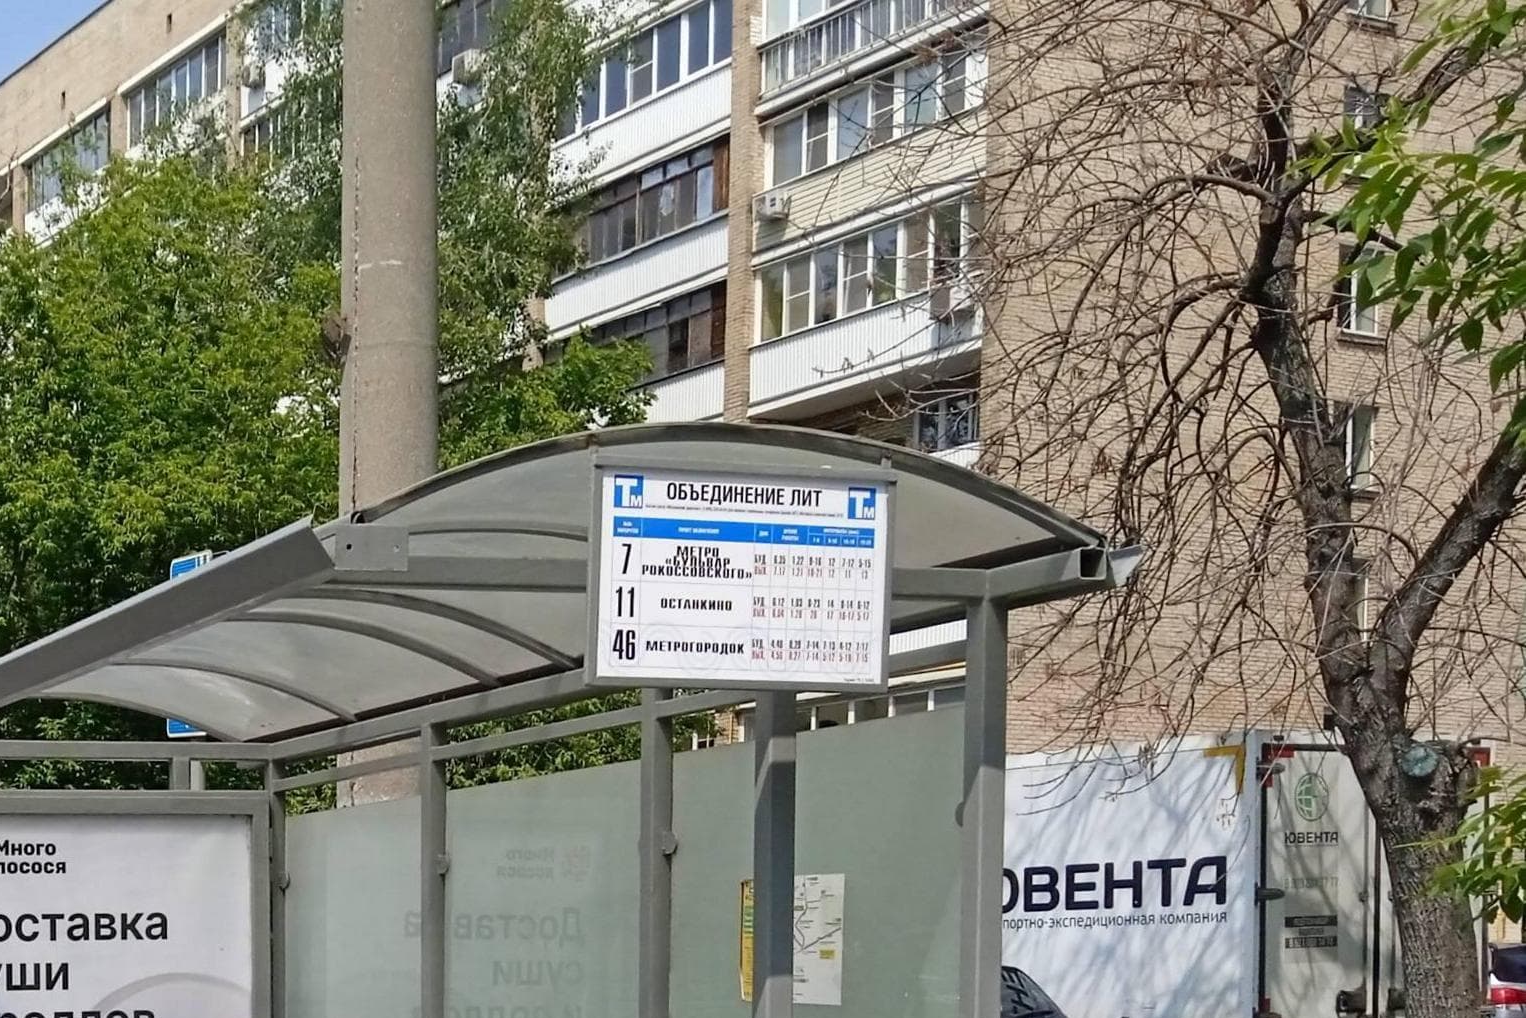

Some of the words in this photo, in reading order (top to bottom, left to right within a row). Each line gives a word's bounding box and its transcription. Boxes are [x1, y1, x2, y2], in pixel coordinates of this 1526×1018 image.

[667, 482, 785, 506] ОБЪЕДИНЕНИЕ
[790, 489, 823, 507] ЛИТ
[621, 543, 632, 575] 7
[676, 545, 720, 558] МЕТРО
[641, 564, 753, 580] РОКОССОВСКОГО»
[615, 586, 635, 618] 11
[660, 598, 733, 612] ОСТАНКИНО
[612, 629, 636, 660] 46
[645, 640, 744, 655] МЕТРОГОРОДОК
[1284, 831, 1339, 844] ЮВЕНТА
[1003, 914, 1155, 931] портно-экспедиционная
[1160, 911, 1227, 926] компания
